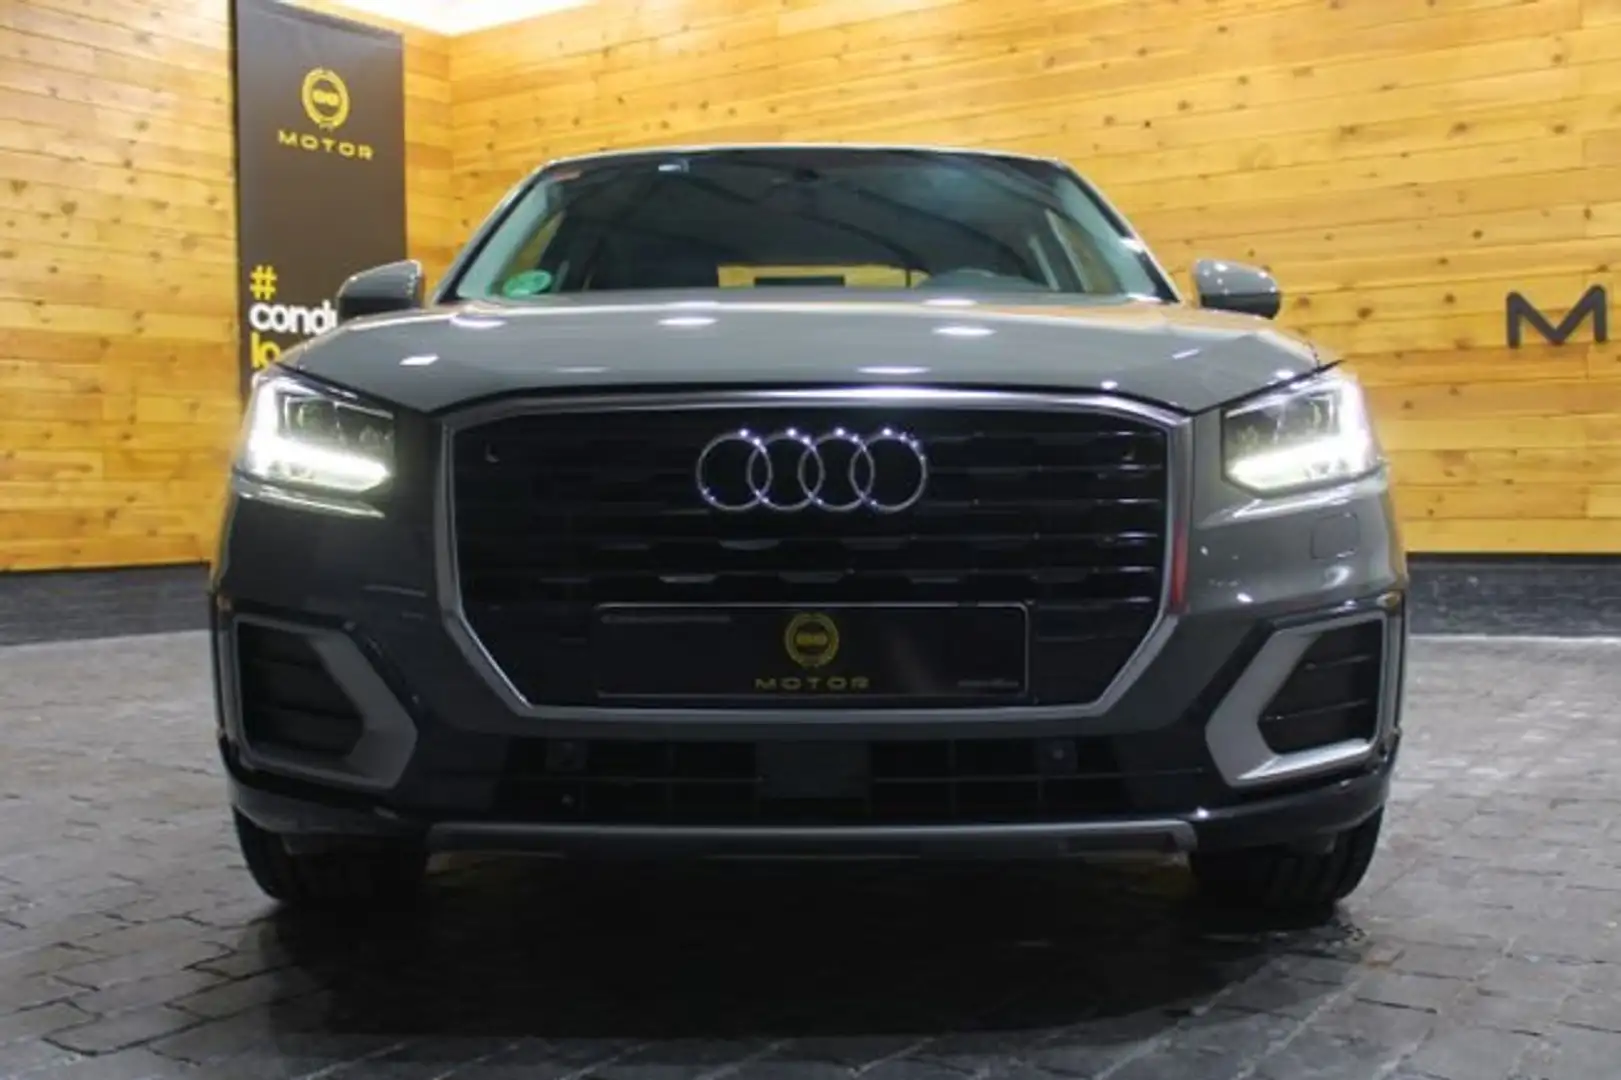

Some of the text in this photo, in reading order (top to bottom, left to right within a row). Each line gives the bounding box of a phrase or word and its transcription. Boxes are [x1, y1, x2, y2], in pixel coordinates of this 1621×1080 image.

[278, 129, 374, 160] MOTOR
[1507, 284, 1608, 349] M
[754, 677, 870, 691] MOTOR
